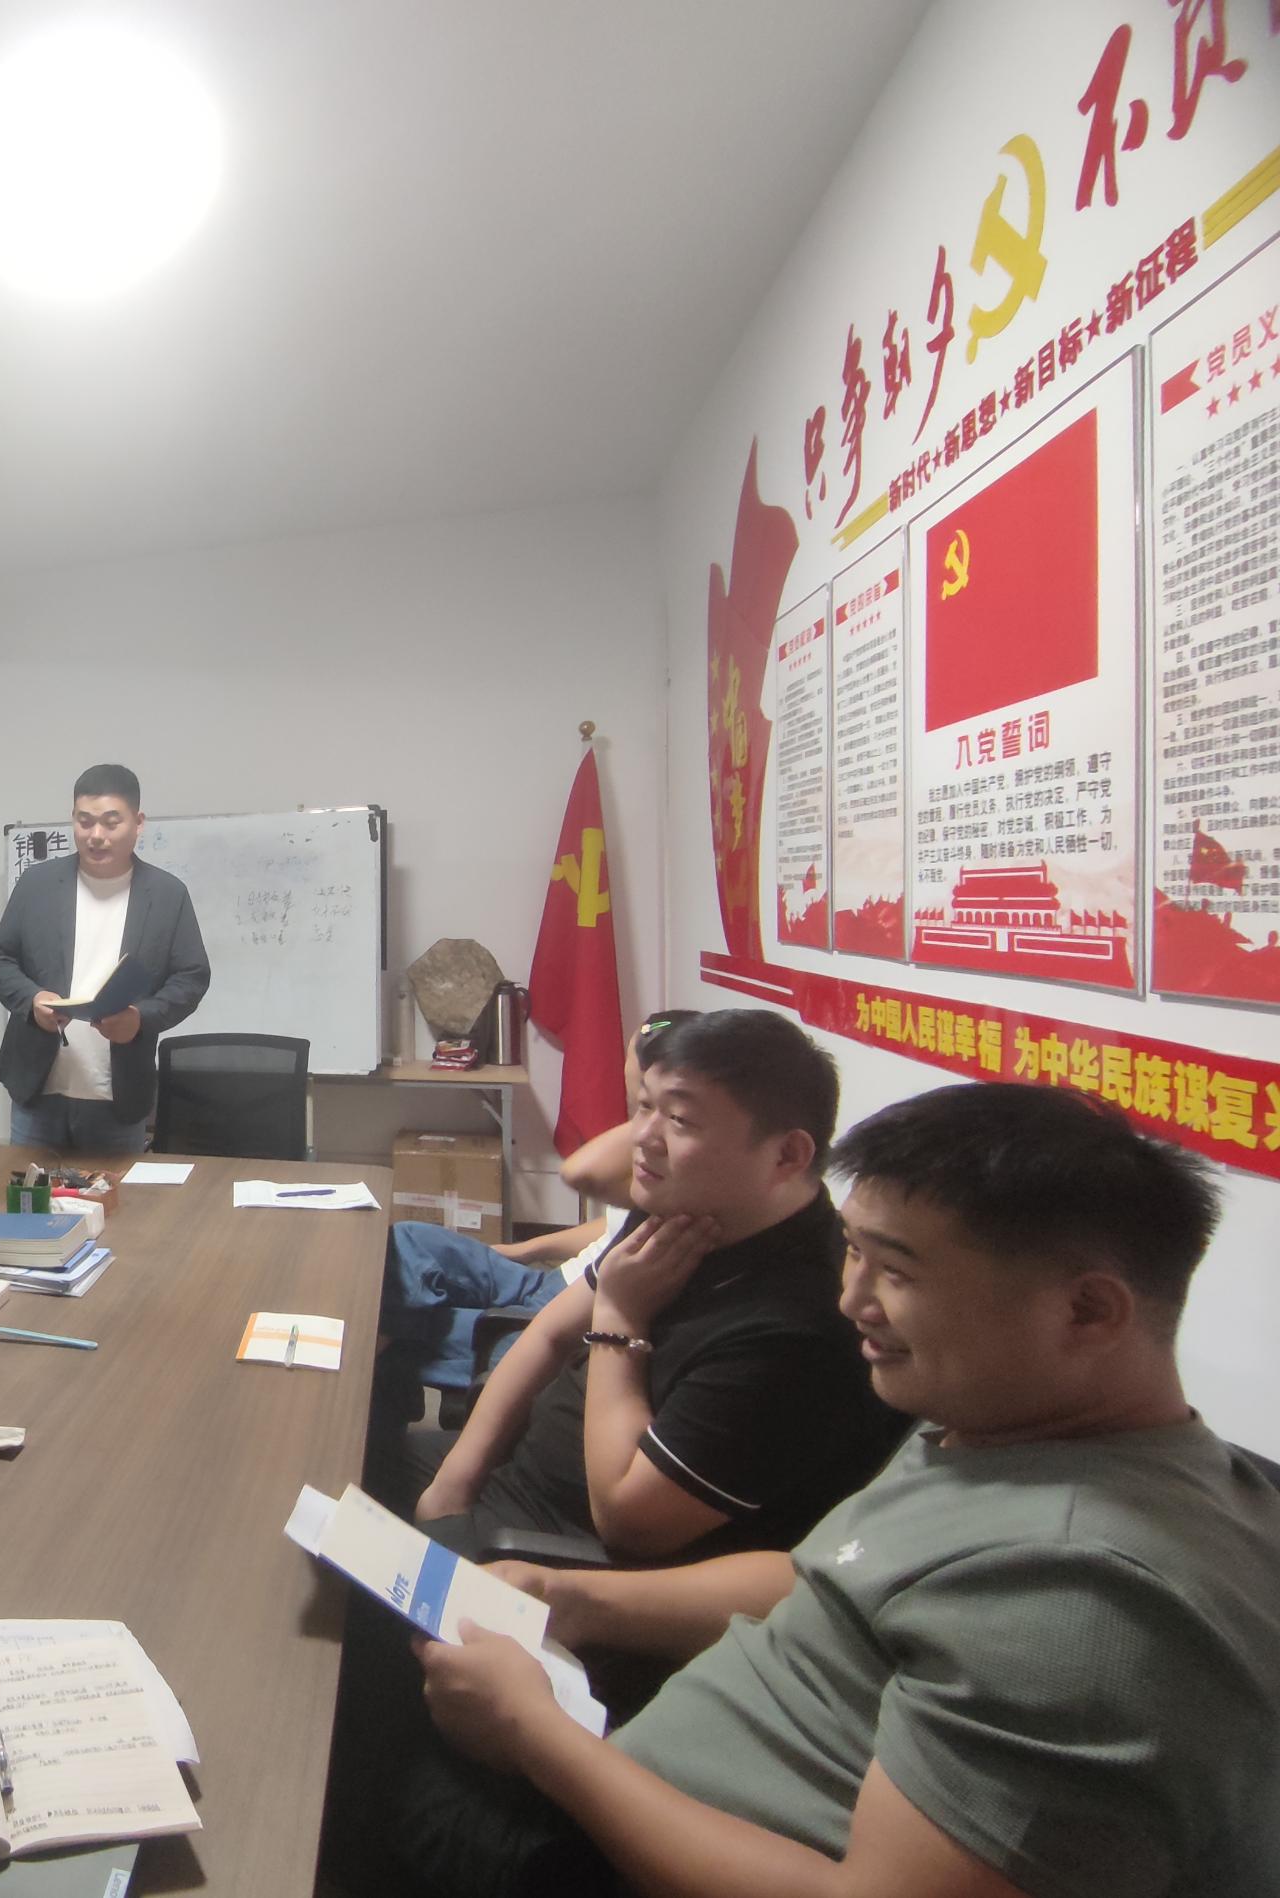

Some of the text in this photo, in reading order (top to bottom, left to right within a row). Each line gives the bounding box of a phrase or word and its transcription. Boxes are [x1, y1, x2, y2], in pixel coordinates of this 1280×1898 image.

[1075, 0, 1280, 212] 不负
[1207, 304, 1280, 384] 党员义
[955, 710, 1050, 770] 入党誓词
[856, 993, 1003, 1074] 为中国人民谋幸福
